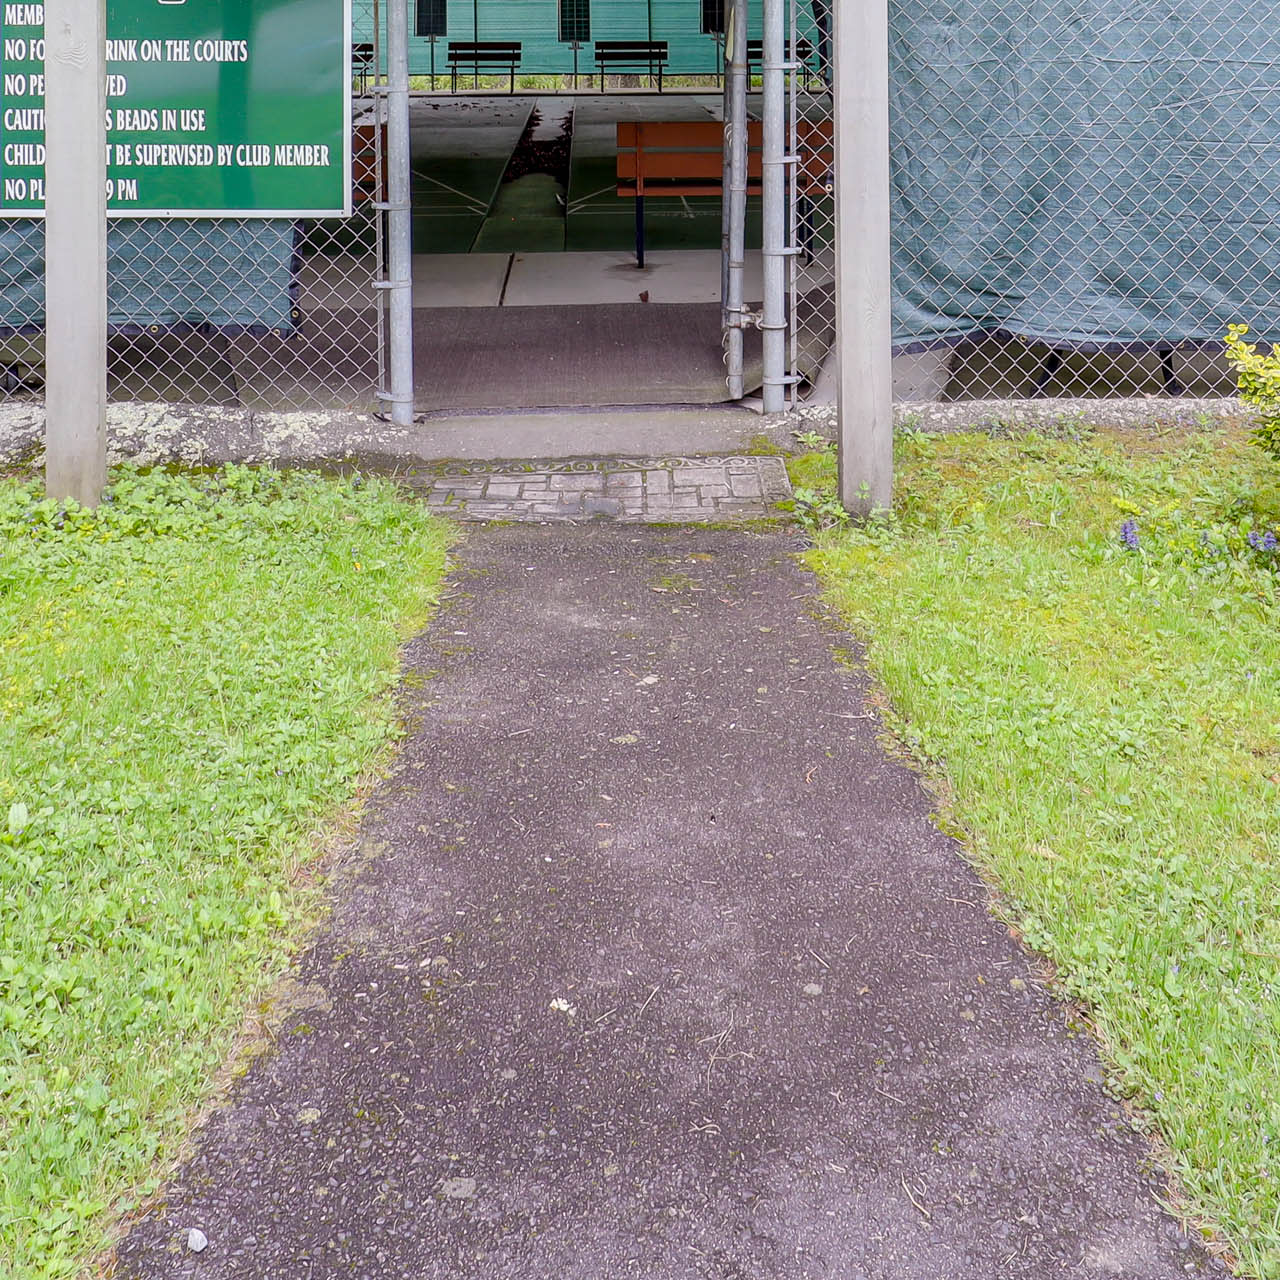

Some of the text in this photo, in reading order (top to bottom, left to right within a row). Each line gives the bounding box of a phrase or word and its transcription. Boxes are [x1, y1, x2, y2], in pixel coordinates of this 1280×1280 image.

[4, 3, 45, 26] MEMB
[4, 38, 248, 62] NO FO RINK ON THE COURTS
[4, 74, 26, 96] NO
[4, 108, 46, 131] CAUTI
[116, 109, 158, 131] BEADS
[161, 109, 177, 131] IN
[180, 109, 206, 131] USE
[4, 143, 46, 166] CHILD
[115, 144, 132, 166] BE
[135, 144, 214, 166] SUPERVISED
[217, 144, 234, 166] BY
[236, 144, 271, 167] CLUB
[274, 144, 330, 166] MEMBER
[4, 178, 27, 201] NO
[29, 179, 45, 201] PL
[117, 179, 138, 201] PM
